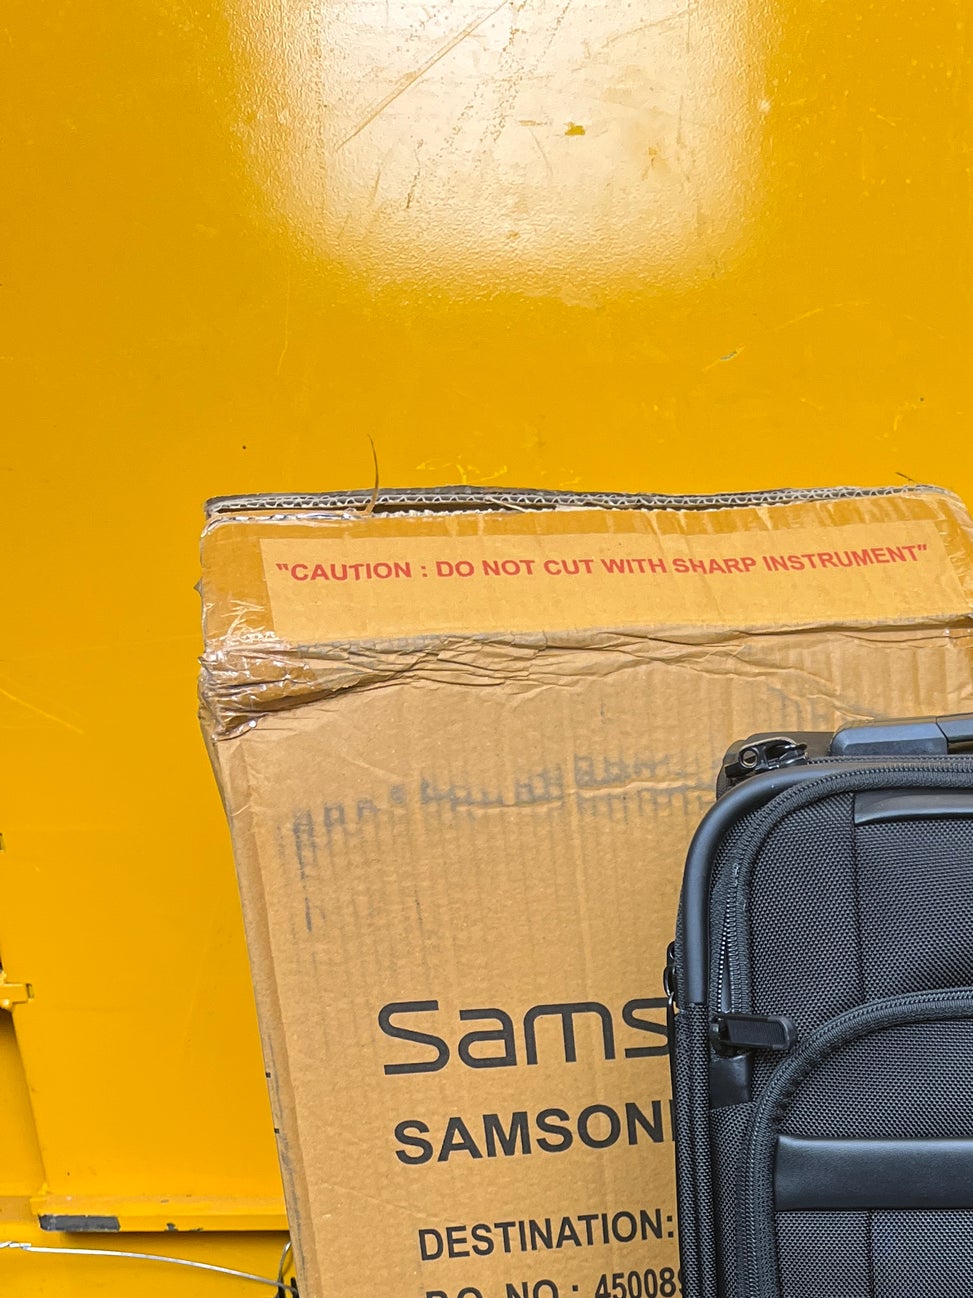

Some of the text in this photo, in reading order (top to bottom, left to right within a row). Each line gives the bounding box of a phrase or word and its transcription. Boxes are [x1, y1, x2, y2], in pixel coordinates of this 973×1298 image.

[276, 562, 412, 581] "CAUTION
[436, 561, 475, 578] DO
[482, 559, 535, 576] NOT
[543, 558, 594, 575] CUT
[601, 558, 667, 574] WITH
[672, 557, 757, 575] SHARP
[762, 543, 928, 572] INSTRUMENT"
[418, 1208, 674, 1261] DESTINATION:
